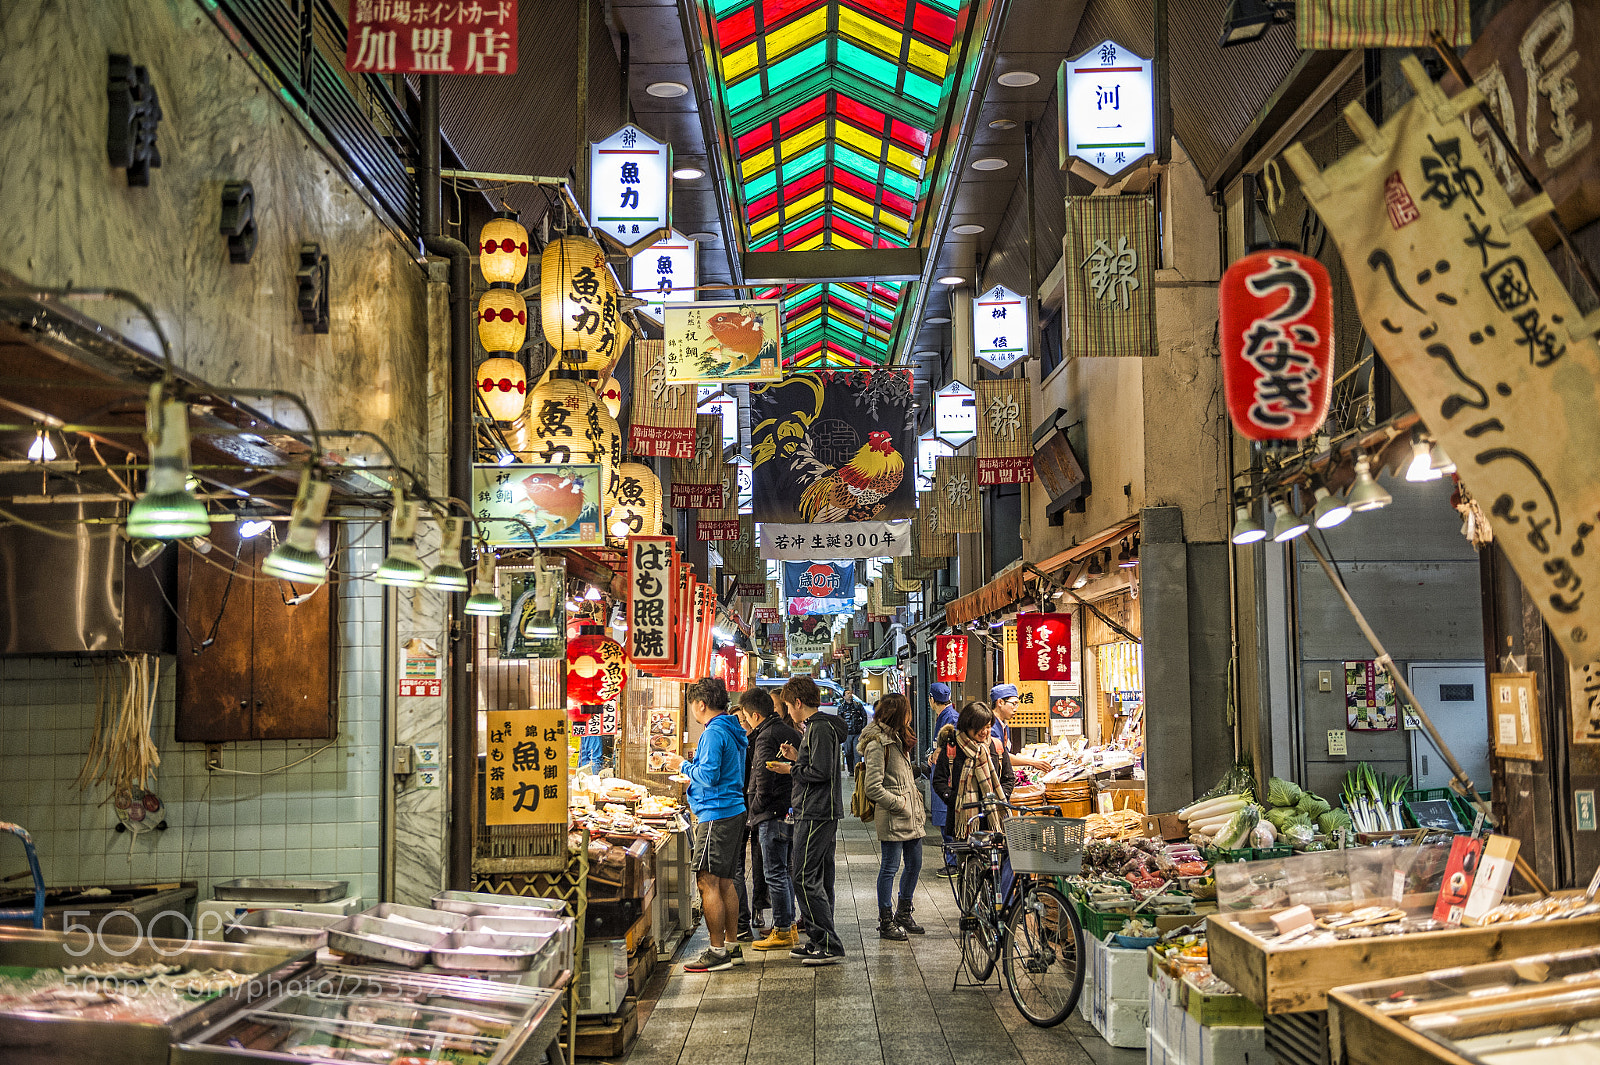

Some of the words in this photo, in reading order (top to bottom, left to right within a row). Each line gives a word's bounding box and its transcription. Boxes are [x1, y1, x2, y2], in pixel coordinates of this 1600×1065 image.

[351, 26, 510, 74] 加盟店
[1097, 44, 1117, 66] 錦
[1095, 84, 1123, 129] 河一
[620, 128, 637, 149] 錦
[1095, 151, 1126, 164] 青果
[620, 161, 641, 210] 魚力
[656, 255, 674, 295] 魚力
[1079, 235, 1140, 311] 錦
[569, 266, 602, 335] 魚力
[685, 329, 699, 358] 祝鯛
[1243, 255, 1319, 429] うなぎ
[564, 395, 580, 411] 錦
[983, 393, 1021, 442] 錦
[632, 437, 693, 459] 加盟店
[633, 426, 694, 441] 錦市場ポイントカード
[979, 458, 1031, 469] 錦市場ポイントカード
[980, 467, 1032, 484] 加盟店
[495, 471, 513, 504] 祝鯛
[672, 493, 721, 509] 加盟店
[942, 473, 972, 511] 錦
[618, 476, 646, 534] 魚力
[697, 528, 739, 541] 加盟店
[774, 534, 806, 550] 若冲
[810, 531, 896, 549] 生誕300年
[798, 572, 841, 589] 歳の市
[633, 543, 664, 657] はも照焼
[400, 685, 440, 695] 加盟店
[525, 725, 538, 738] 錦
[603, 699, 616, 734] もカツ
[490, 730, 505, 801] はも茶漬
[512, 741, 540, 813] 魚力
[543, 728, 558, 799] はも御飯
